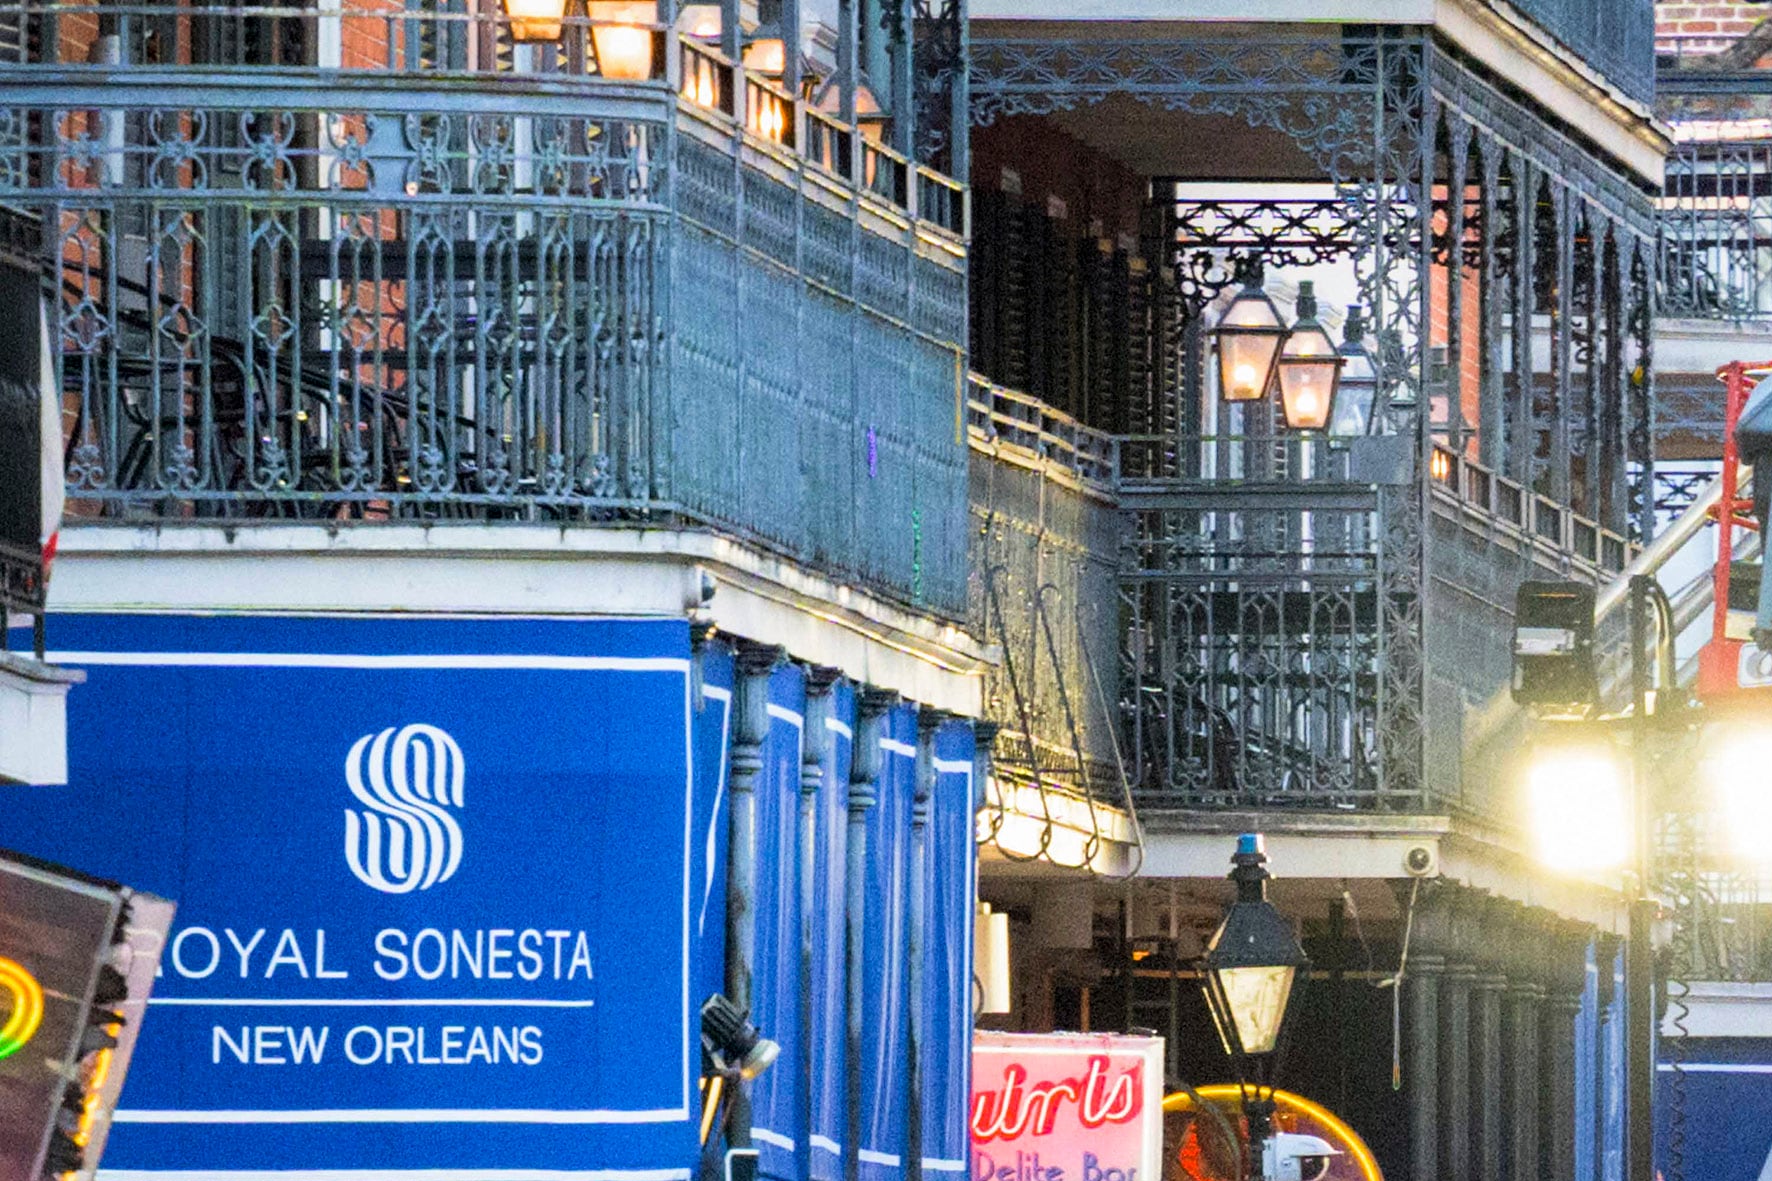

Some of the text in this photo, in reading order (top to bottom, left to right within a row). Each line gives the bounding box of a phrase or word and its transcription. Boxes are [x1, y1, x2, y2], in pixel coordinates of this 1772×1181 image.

[155, 927, 595, 981] OYAL SONESTA
[211, 1025, 544, 1066] NEW ORLEANS
